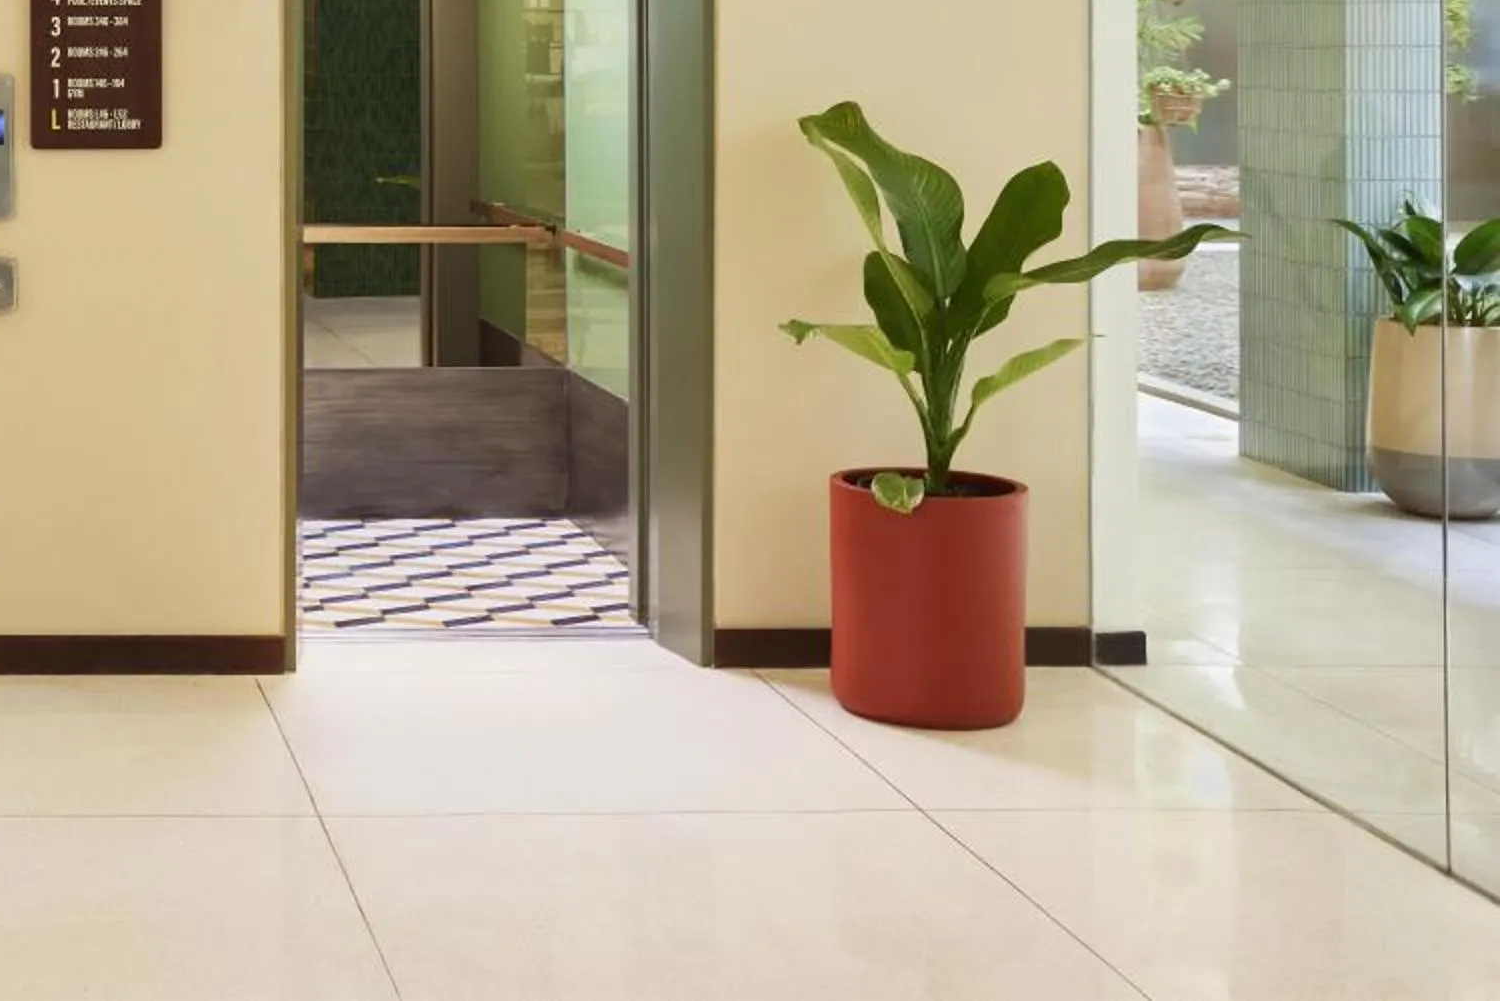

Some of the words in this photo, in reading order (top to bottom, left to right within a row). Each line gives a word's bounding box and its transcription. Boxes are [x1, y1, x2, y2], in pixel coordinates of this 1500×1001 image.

[51, 17, 61, 36] 3
[67, 16, 93, 26] ROOMS
[51, 47, 61, 67] 2
[67, 46, 94, 58] ROOMS
[53, 78, 60, 99] 1
[67, 78, 94, 88] ROOMS
[51, 109, 61, 130] L
[67, 108, 94, 119] ROOMS
